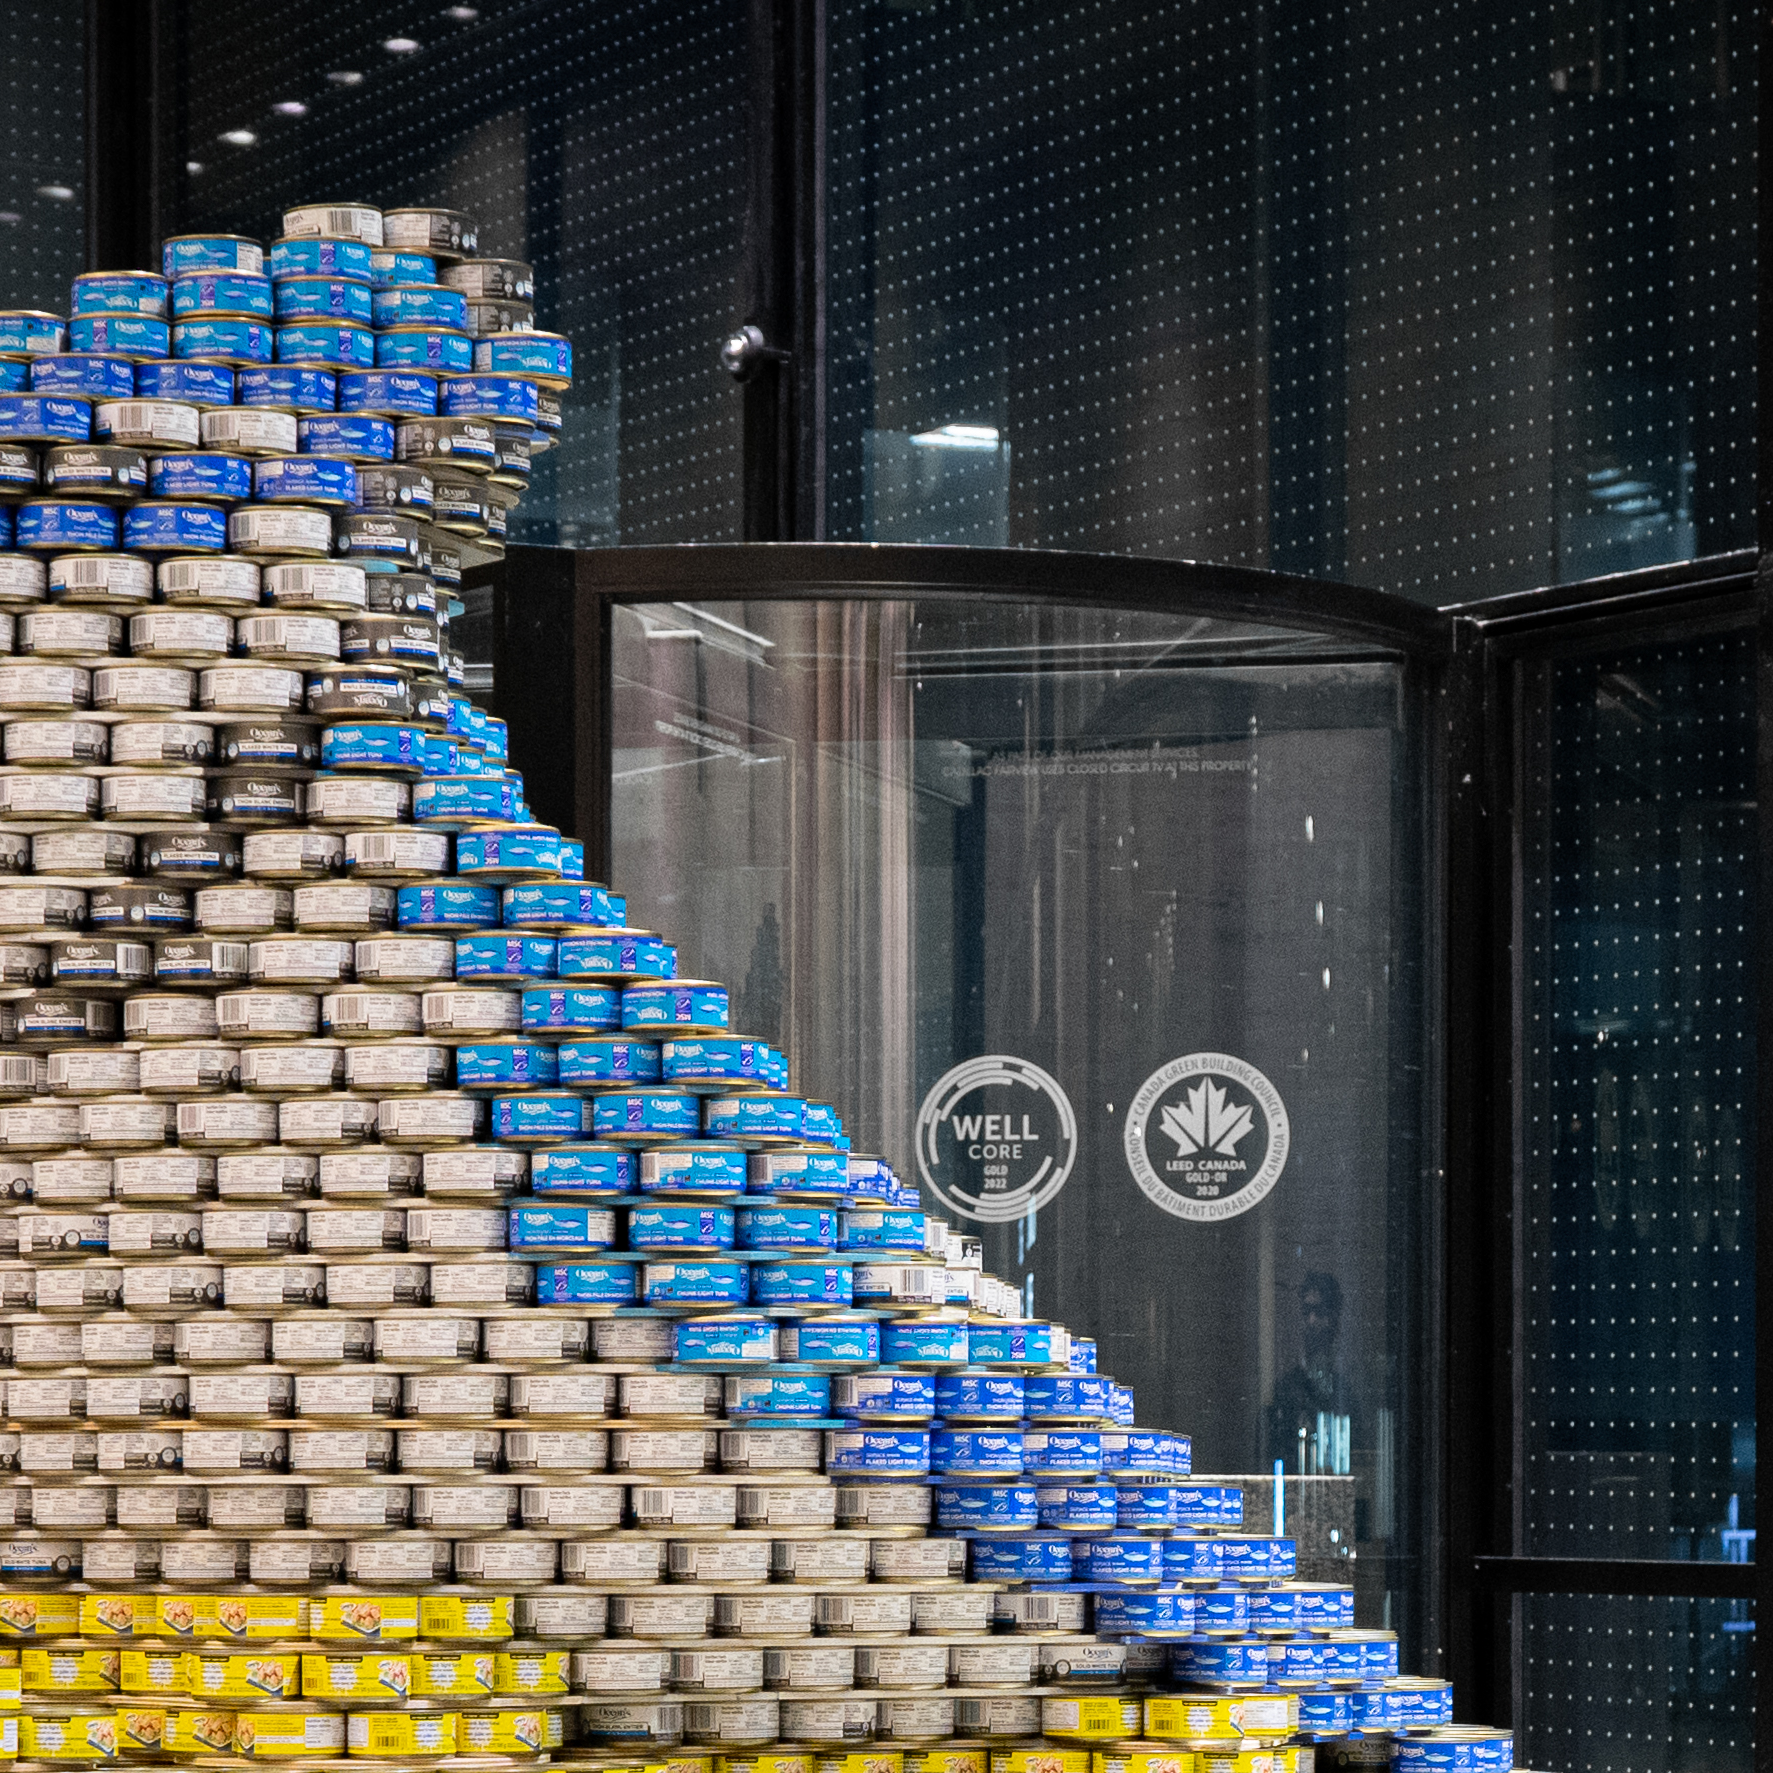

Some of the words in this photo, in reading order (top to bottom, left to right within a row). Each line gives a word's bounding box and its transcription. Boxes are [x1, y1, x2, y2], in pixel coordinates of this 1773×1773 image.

[339, 330, 352, 338] MSC
[161, 366, 176, 374] MSC
[613, 1045, 628, 1053] MSC
[741, 1043, 754, 1051] MSC
[1135, 1075, 1165, 1116] CANADA
[1165, 1059, 1199, 1081] GREEN
[1201, 1057, 1252, 1081] BUILDING
[1251, 1076, 1282, 1118] COUNCIL
[952, 1114, 1039, 1141] WELL
[968, 1144, 1023, 1159] CORE
[1166, 1160, 1194, 1171] LEED
[1198, 1160, 1247, 1171] CANADA
[983, 1164, 1009, 1176] GOLD
[1128, 1131, 1146, 1174] CONSEIL
[1142, 1175, 1157, 1193] DU
[1153, 1188, 1205, 1217] BÂTIMENT
[1209, 1192, 1257, 1217] DURABLE
[1255, 1177, 1270, 1195] DU
[1266, 1133, 1287, 1178] CANADA
[983, 1178, 1007, 1189] 2022
[1196, 1185, 1220, 1196] 2020
[700, 1211, 714, 1219] MSC
[962, 1380, 979, 1388] MSC
[1057, 1380, 1073, 1388] MSC
[954, 1435, 970, 1443] MSC
[992, 1490, 1008, 1498] MSC
[1027, 1544, 1042, 1552] MSC
